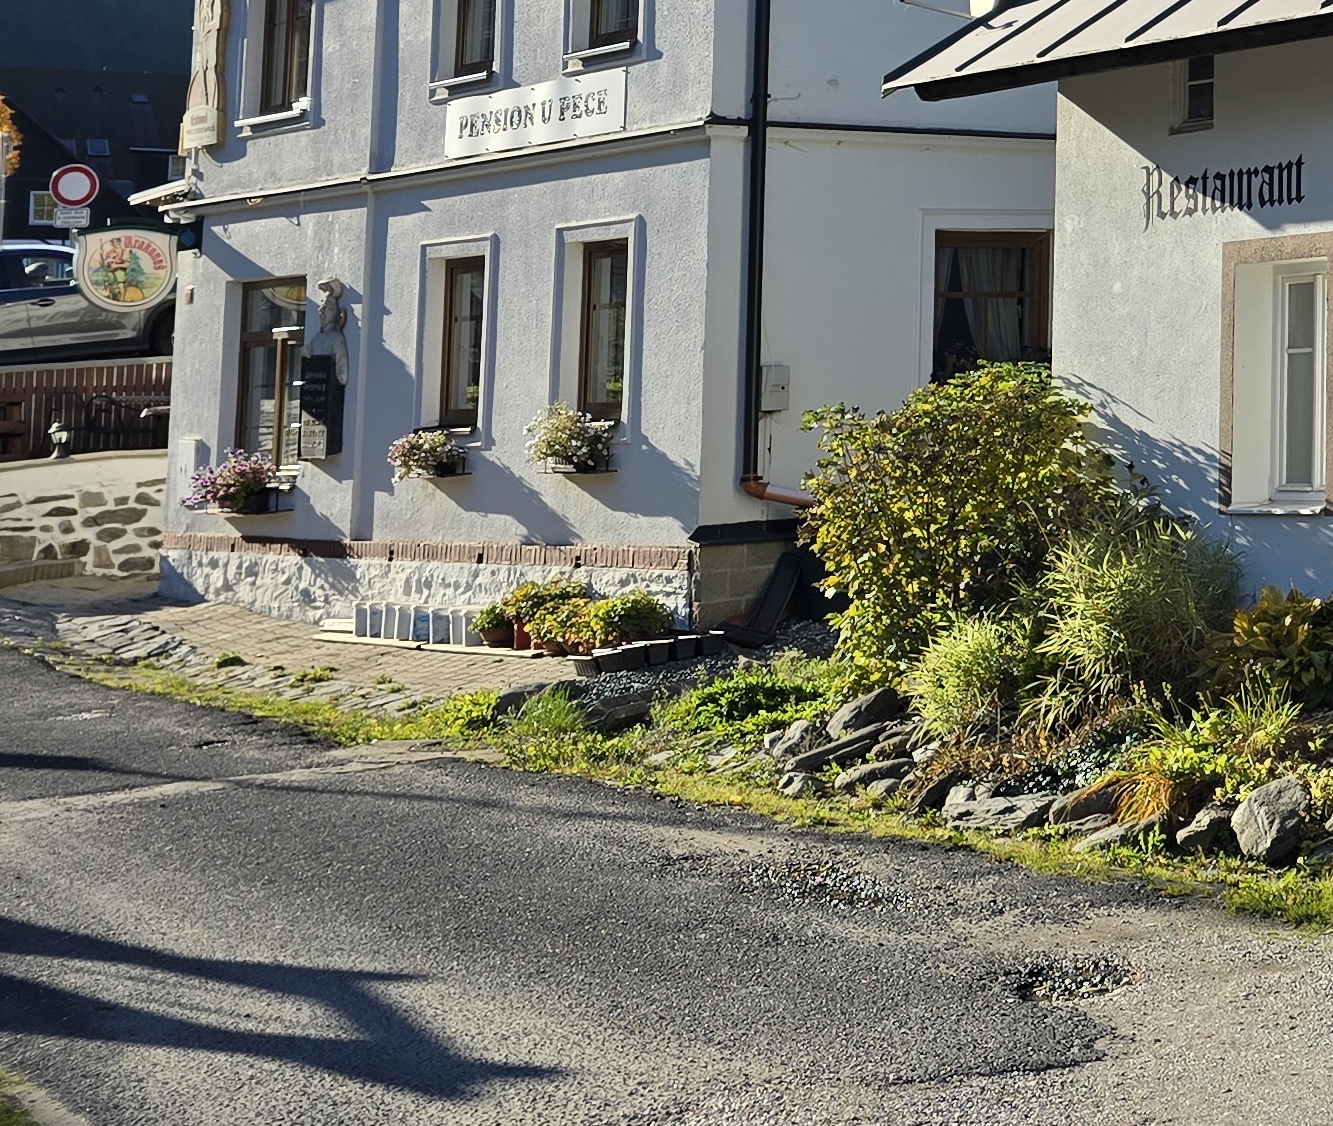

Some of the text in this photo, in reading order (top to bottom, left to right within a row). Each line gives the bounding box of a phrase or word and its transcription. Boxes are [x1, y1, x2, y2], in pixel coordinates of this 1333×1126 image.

[458, 88, 608, 139] PENSION U PECE
[1142, 153, 1306, 233] Restaurant
